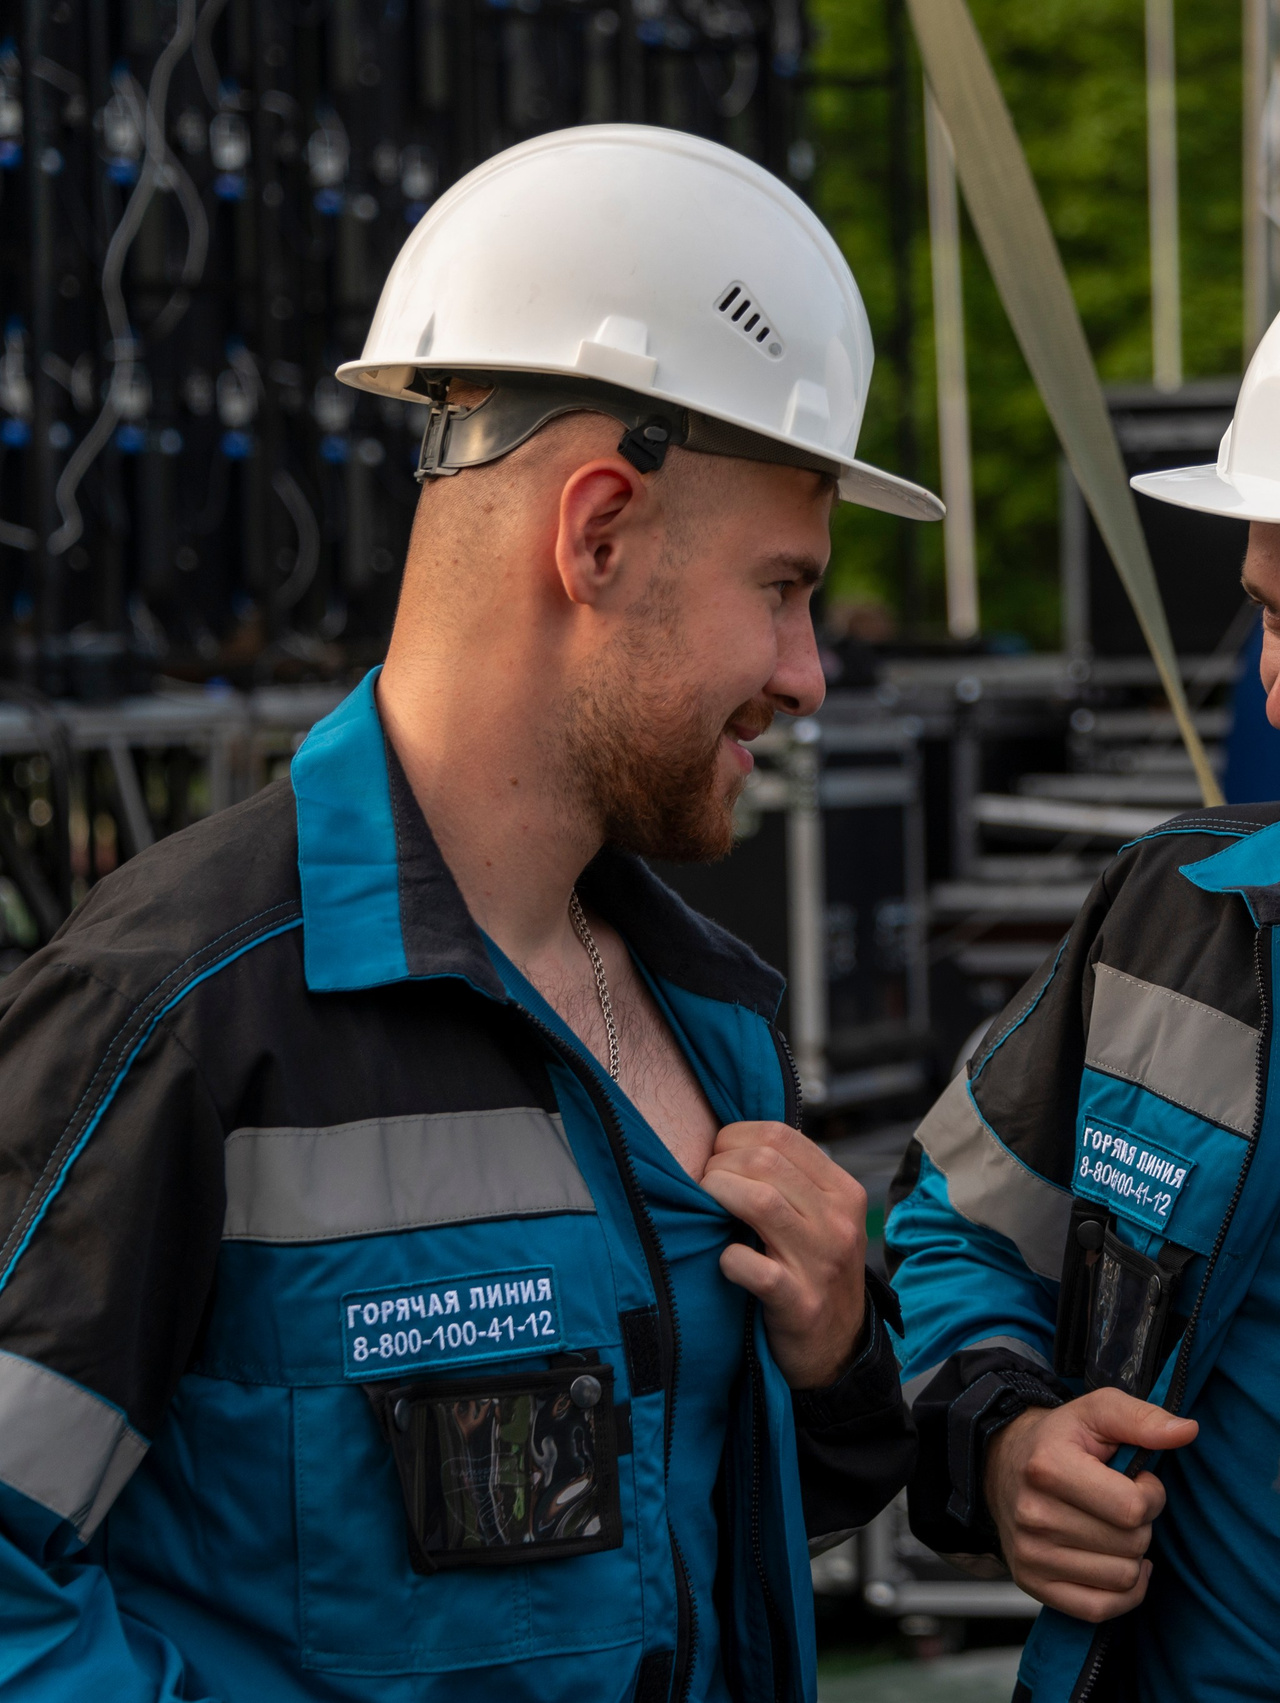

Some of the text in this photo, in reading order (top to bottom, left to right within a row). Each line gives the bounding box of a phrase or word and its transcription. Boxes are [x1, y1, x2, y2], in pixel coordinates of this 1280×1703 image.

[1136, 1151, 1187, 1189] ЛИНИЯ
[347, 1278, 552, 1329] ГОРЯЧАЯ ЛИНИЯ
[353, 1310, 556, 1362] 8-800-100-41-12
